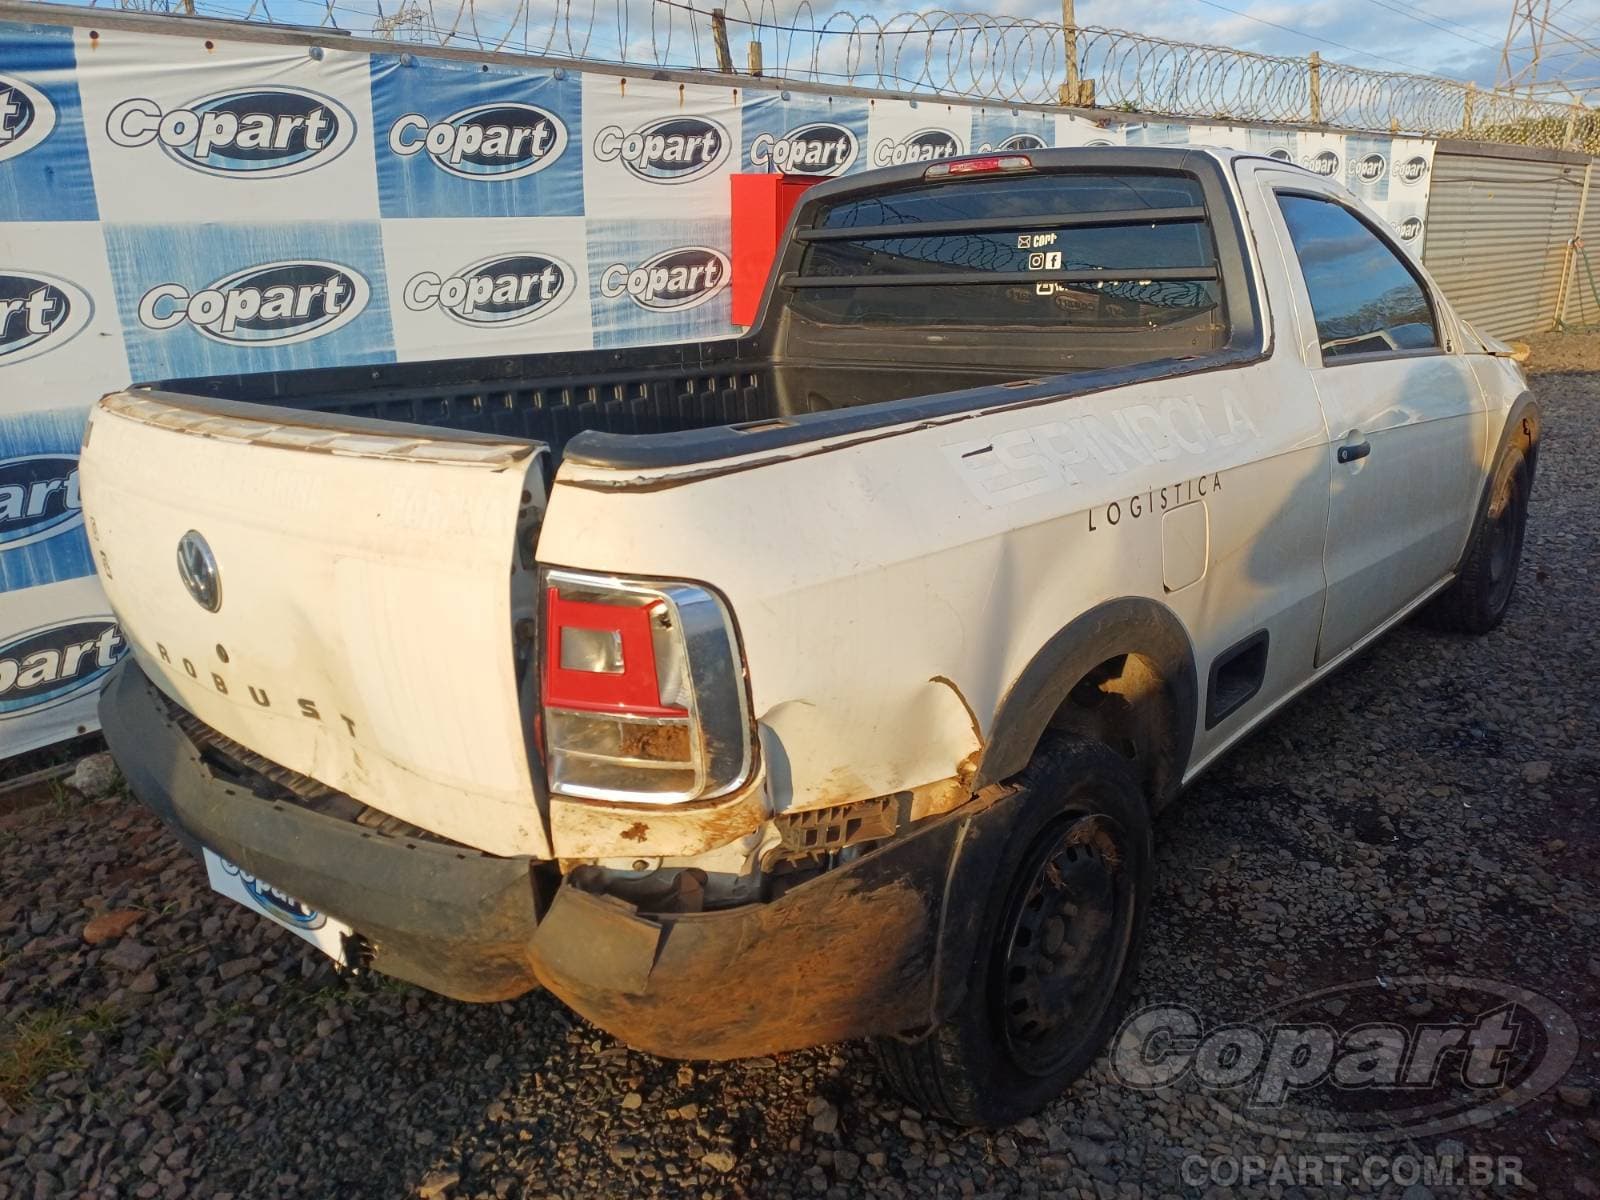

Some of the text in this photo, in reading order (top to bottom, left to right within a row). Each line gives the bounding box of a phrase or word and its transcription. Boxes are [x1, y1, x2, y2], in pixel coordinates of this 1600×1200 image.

[106, 98, 329, 157] Copart
[389, 113, 550, 164] Copart
[594, 126, 716, 169] Copart
[750, 133, 851, 170] Copart
[1349, 158, 1385, 177] Copart
[138, 273, 347, 332] Copart
[403, 264, 557, 314] Copart
[600, 259, 719, 301] Copart
[0, 466, 83, 520] art
[156, 642, 356, 738] ROBUST
